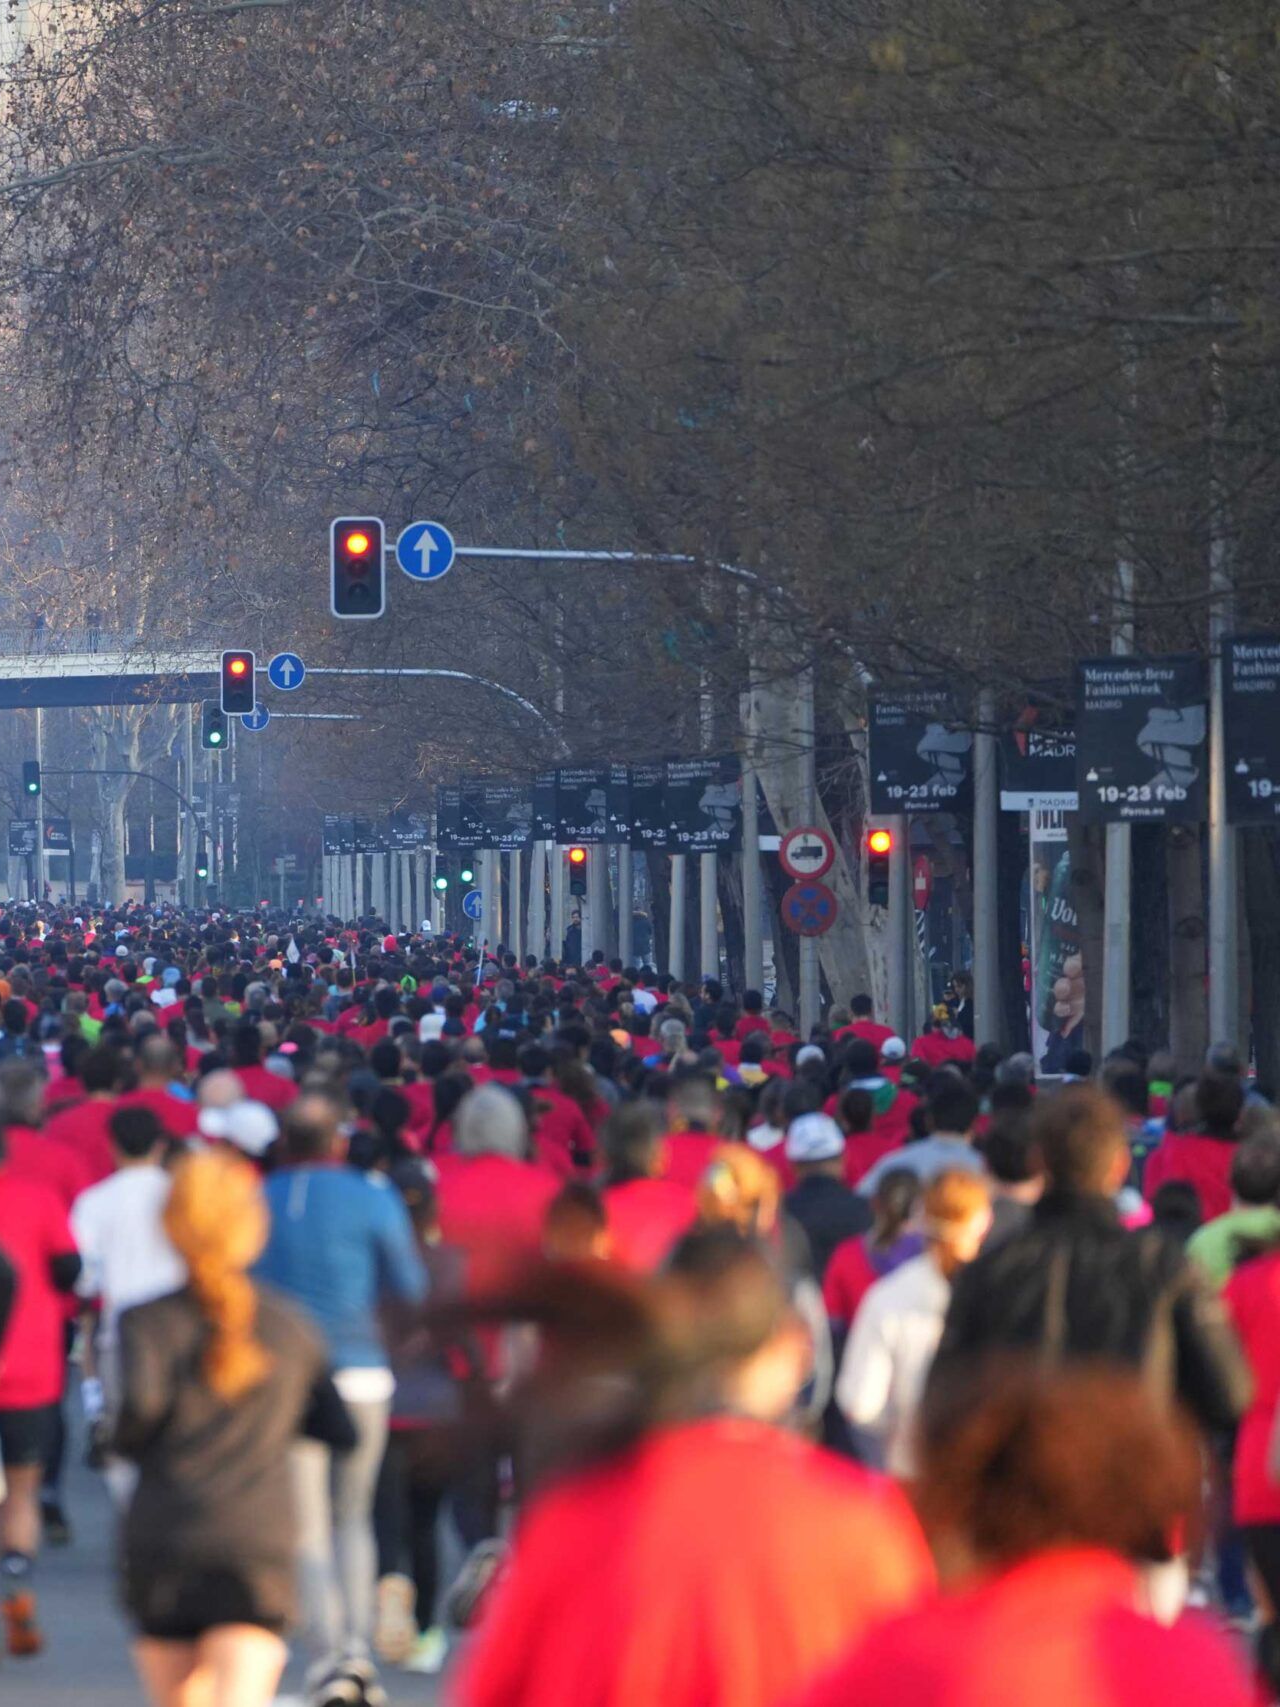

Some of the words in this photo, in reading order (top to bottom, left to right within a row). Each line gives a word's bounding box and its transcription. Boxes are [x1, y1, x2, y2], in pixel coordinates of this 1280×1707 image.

[1085, 668, 1175, 681] Mercedes-Benz
[1085, 683, 1162, 696] FashionWeek
[886, 784, 929, 798] 19-23
[932, 783, 958, 797] feb
[1097, 785, 1151, 802] 19-23
[1155, 783, 1188, 801] feb
[566, 826, 592, 835] 19-23
[676, 831, 709, 842] 19-23
[710, 830, 731, 840] feb
[490, 834, 513, 843] 19-23
[513, 834, 528, 842] feb
